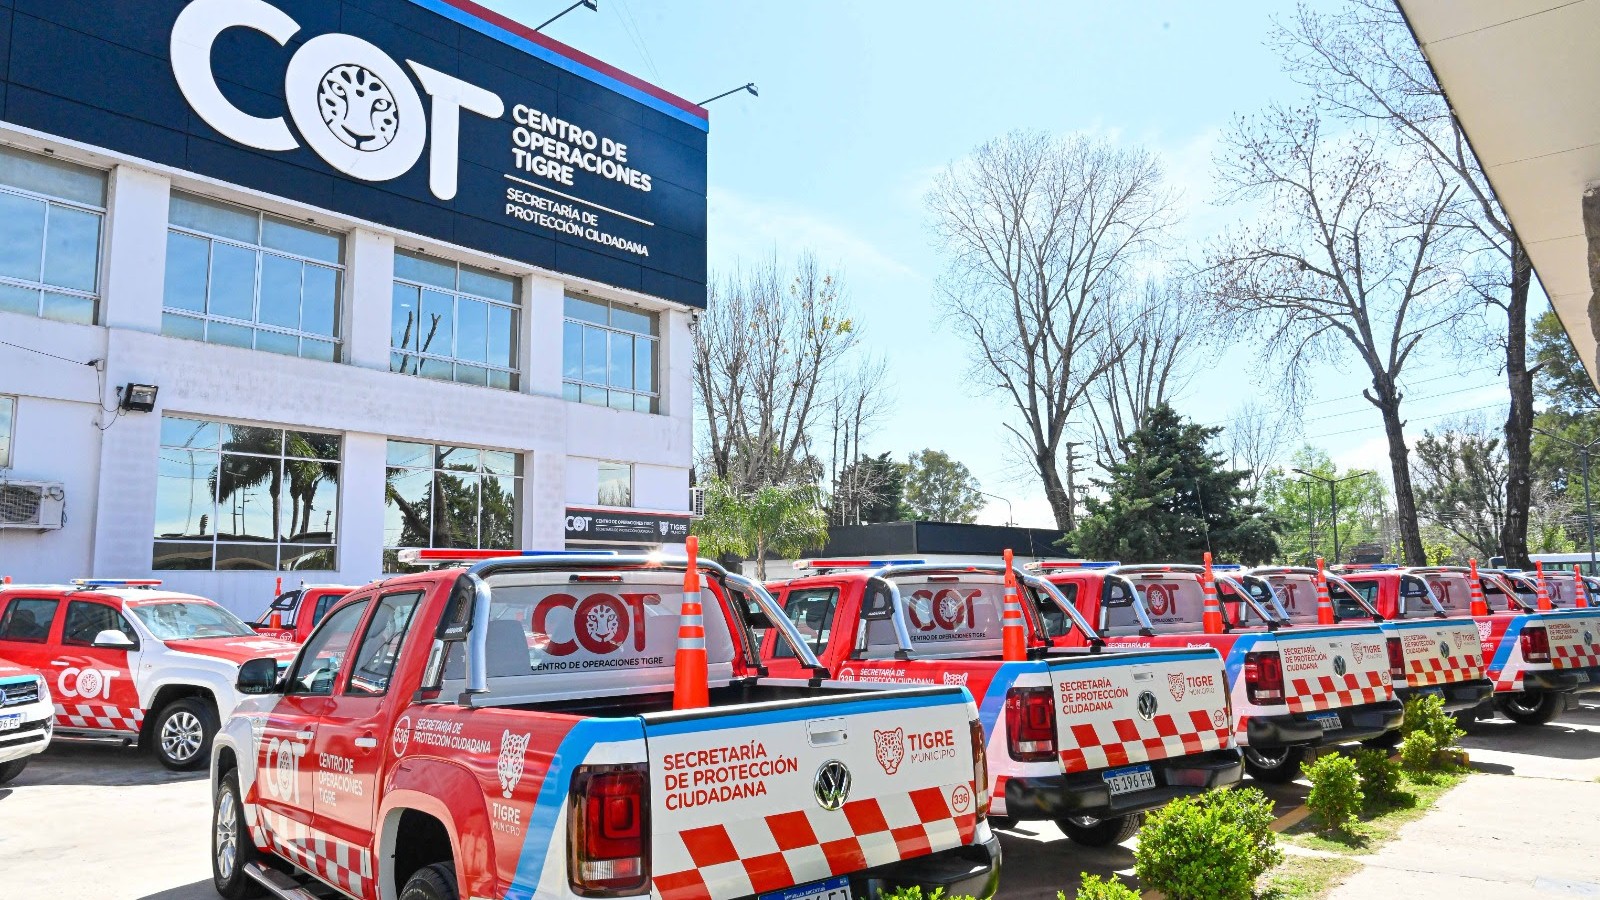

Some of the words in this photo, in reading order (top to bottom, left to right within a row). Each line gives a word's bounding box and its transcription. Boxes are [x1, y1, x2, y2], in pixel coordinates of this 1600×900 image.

[170, 0, 504, 200] COT
[512, 104, 597, 150] CENTRO
[601, 137, 627, 163] DE
[511, 147, 574, 186] TIGRE
[512, 126, 652, 192] OPERACIONES
[506, 187, 580, 221] SECRETARÍA
[582, 212, 598, 227] DE
[505, 203, 584, 237] PROTECCIÓN
[585, 229, 649, 257] CIUDADANA
[565, 515, 593, 532] COT
[669, 523, 687, 531] TIGRE
[908, 589, 982, 632] COT
[531, 593, 662, 656] COT
[911, 634, 930, 642] CENTRO
[1363, 645, 1381, 653] TIGRE
[531, 661, 566, 671] CENTRO
[569, 660, 581, 669] DE
[582, 658, 640, 668] OPERACIONES
[641, 656, 664, 665] TIGRE
[860, 667, 895, 677] SECRETARÍA
[895, 669, 905, 677] DE
[58, 667, 120, 699] COT
[1060, 677, 1112, 691] SECRETARÍA
[1186, 675, 1214, 688] TIGRE
[1061, 693, 1074, 703] DE
[1075, 686, 1129, 702] PROTECCIÓN
[1063, 701, 1113, 715] CIUDADANA
[415, 719, 452, 734] SECRETARÍA
[452, 722, 463, 734] DE
[413, 731, 451, 748] PROTECCIÓN
[451, 737, 491, 753] CIUDADANA
[908, 729, 955, 752] TIGRE
[319, 752, 344, 774] CENTRO
[344, 758, 354, 775] DE
[663, 740, 767, 771] SECRETARÍA
[911, 748, 956, 764] MUNICIPIO
[266, 737, 305, 804] COT
[665, 772, 689, 791] DE
[693, 754, 798, 786] PROTECCIÓN
[319, 770, 363, 796] OPERACIONES
[1109, 779, 1120, 792] AG
[1121, 775, 1138, 790] 196
[319, 787, 336, 807] TIGRE
[665, 780, 767, 811] CIUDADANA
[954, 793, 968, 805] 336
[492, 802, 520, 825] TIGRE
